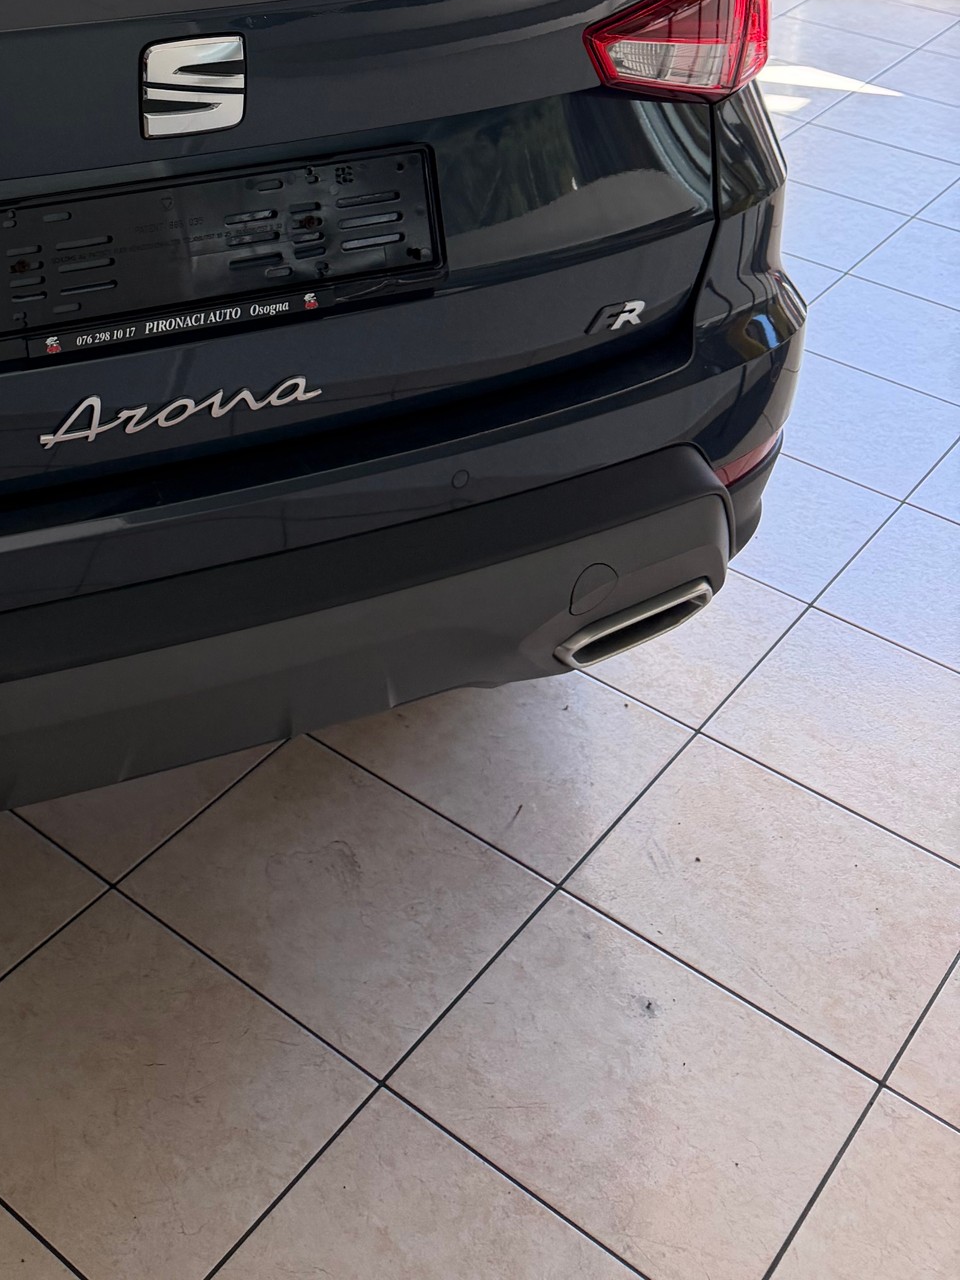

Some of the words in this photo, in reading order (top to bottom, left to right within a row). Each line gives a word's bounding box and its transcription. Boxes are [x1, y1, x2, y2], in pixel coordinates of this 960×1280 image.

[76, 335, 93, 346] 076
[94, 331, 111, 344] 298
[113, 328, 124, 341] 10
[125, 326, 136, 339] 17
[144, 313, 205, 335] PIRONACI
[207, 306, 241, 324] AUTO
[249, 301, 289, 317] Osogna
[584, 299, 645, 336] FR
[40, 375, 323, 450] Arona
